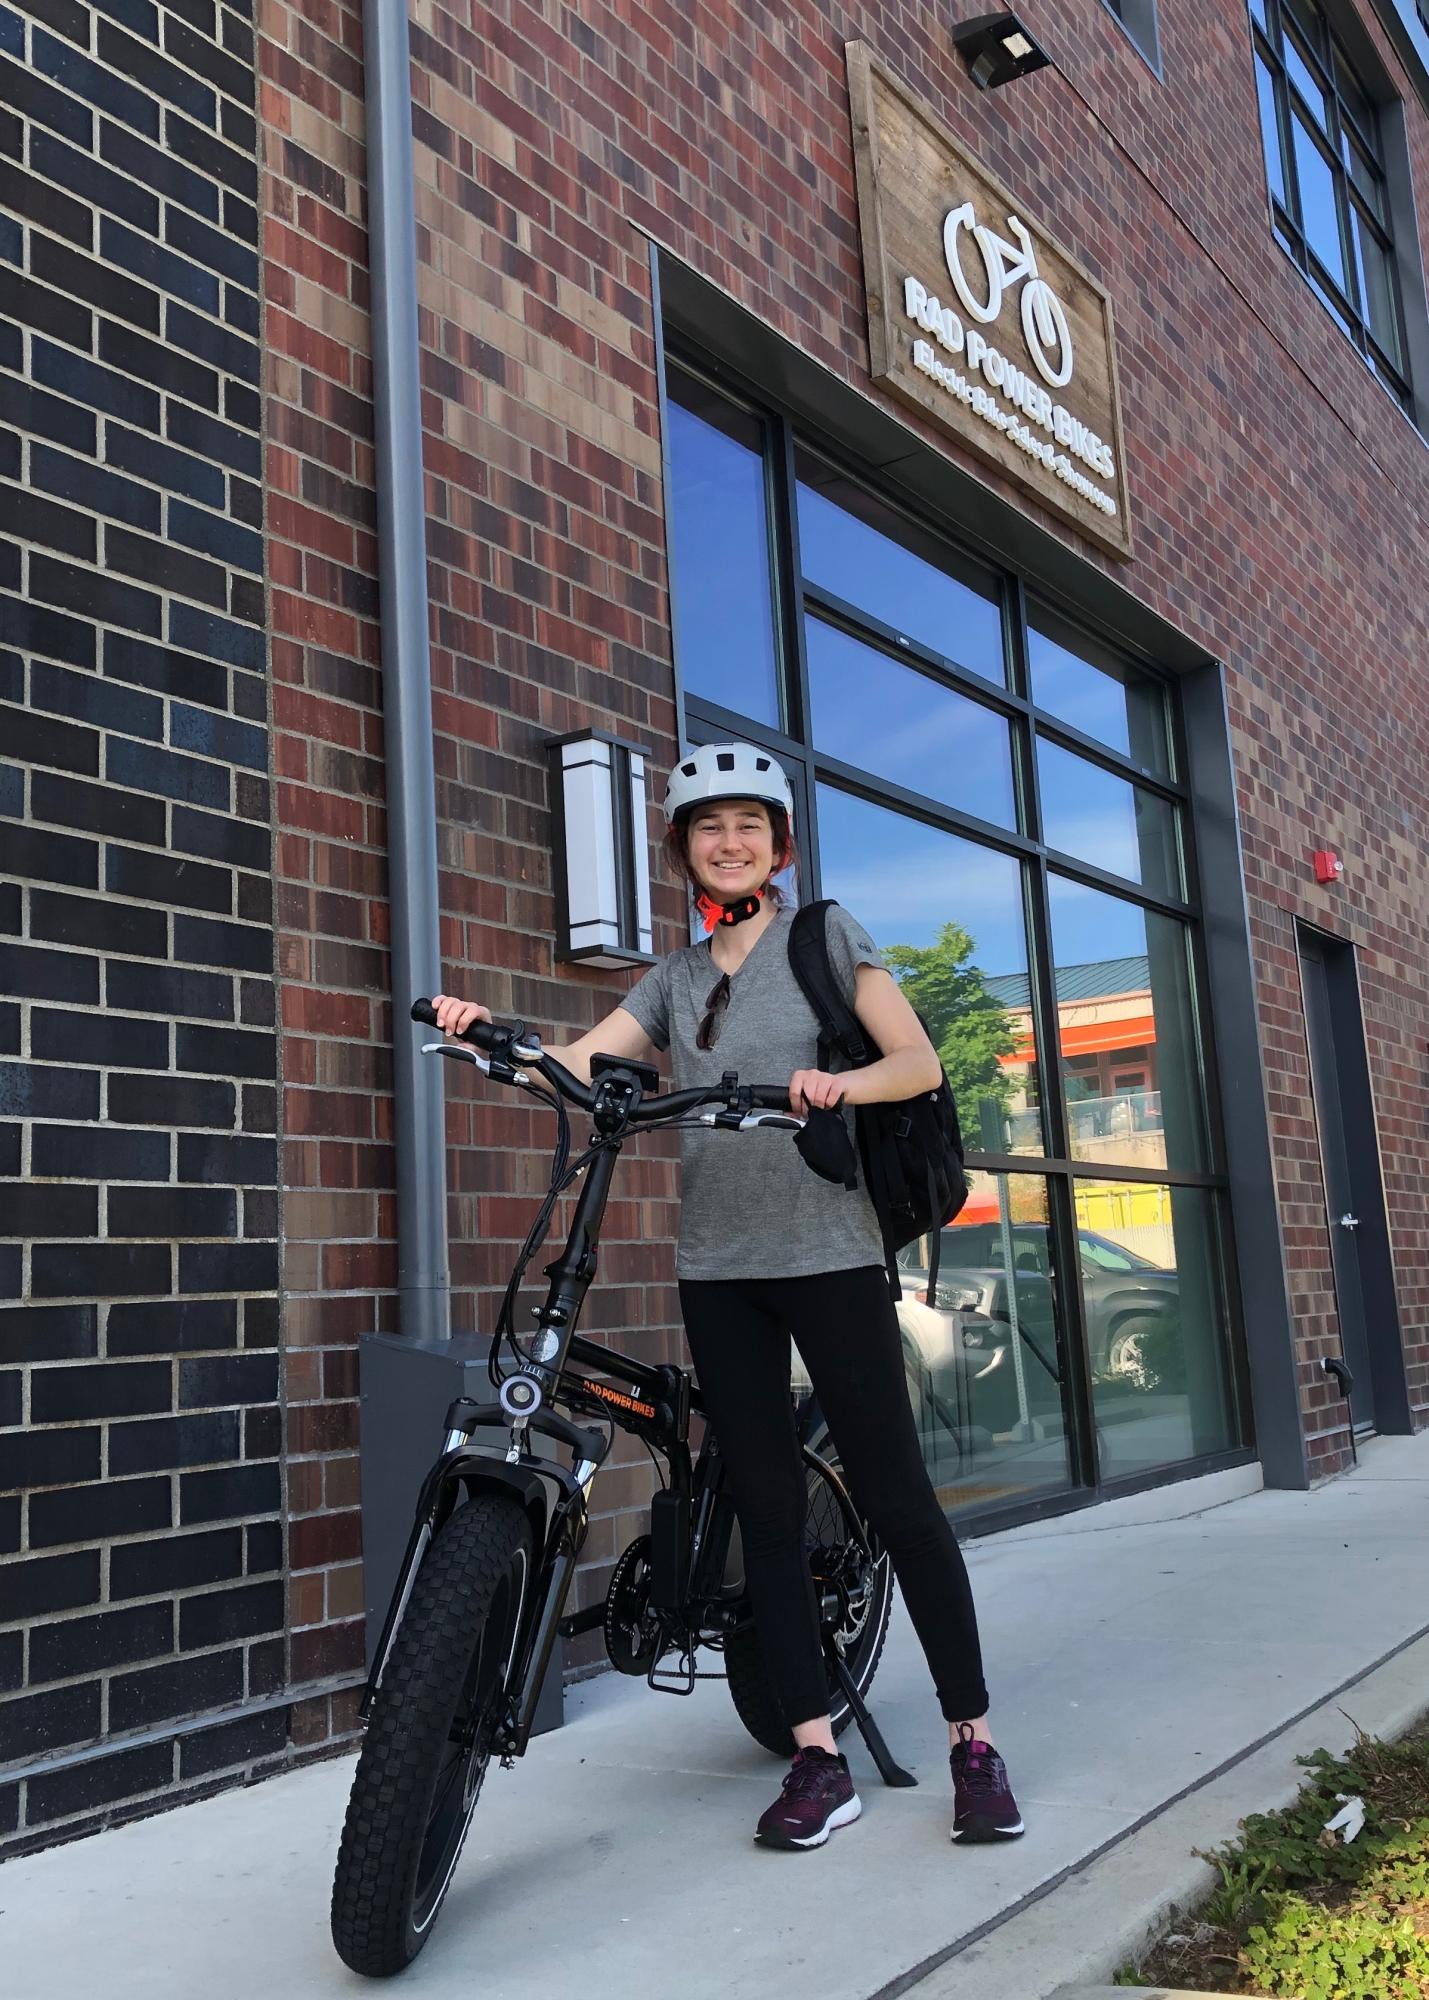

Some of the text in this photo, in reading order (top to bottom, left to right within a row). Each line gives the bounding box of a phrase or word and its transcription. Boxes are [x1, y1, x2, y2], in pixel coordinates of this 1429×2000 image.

[905, 277, 1115, 479] RAD POWER BIKES
[914, 339, 973, 404] Electric
[601, 1387, 632, 1409] POWER
[632, 1400, 656, 1418] BIKES
